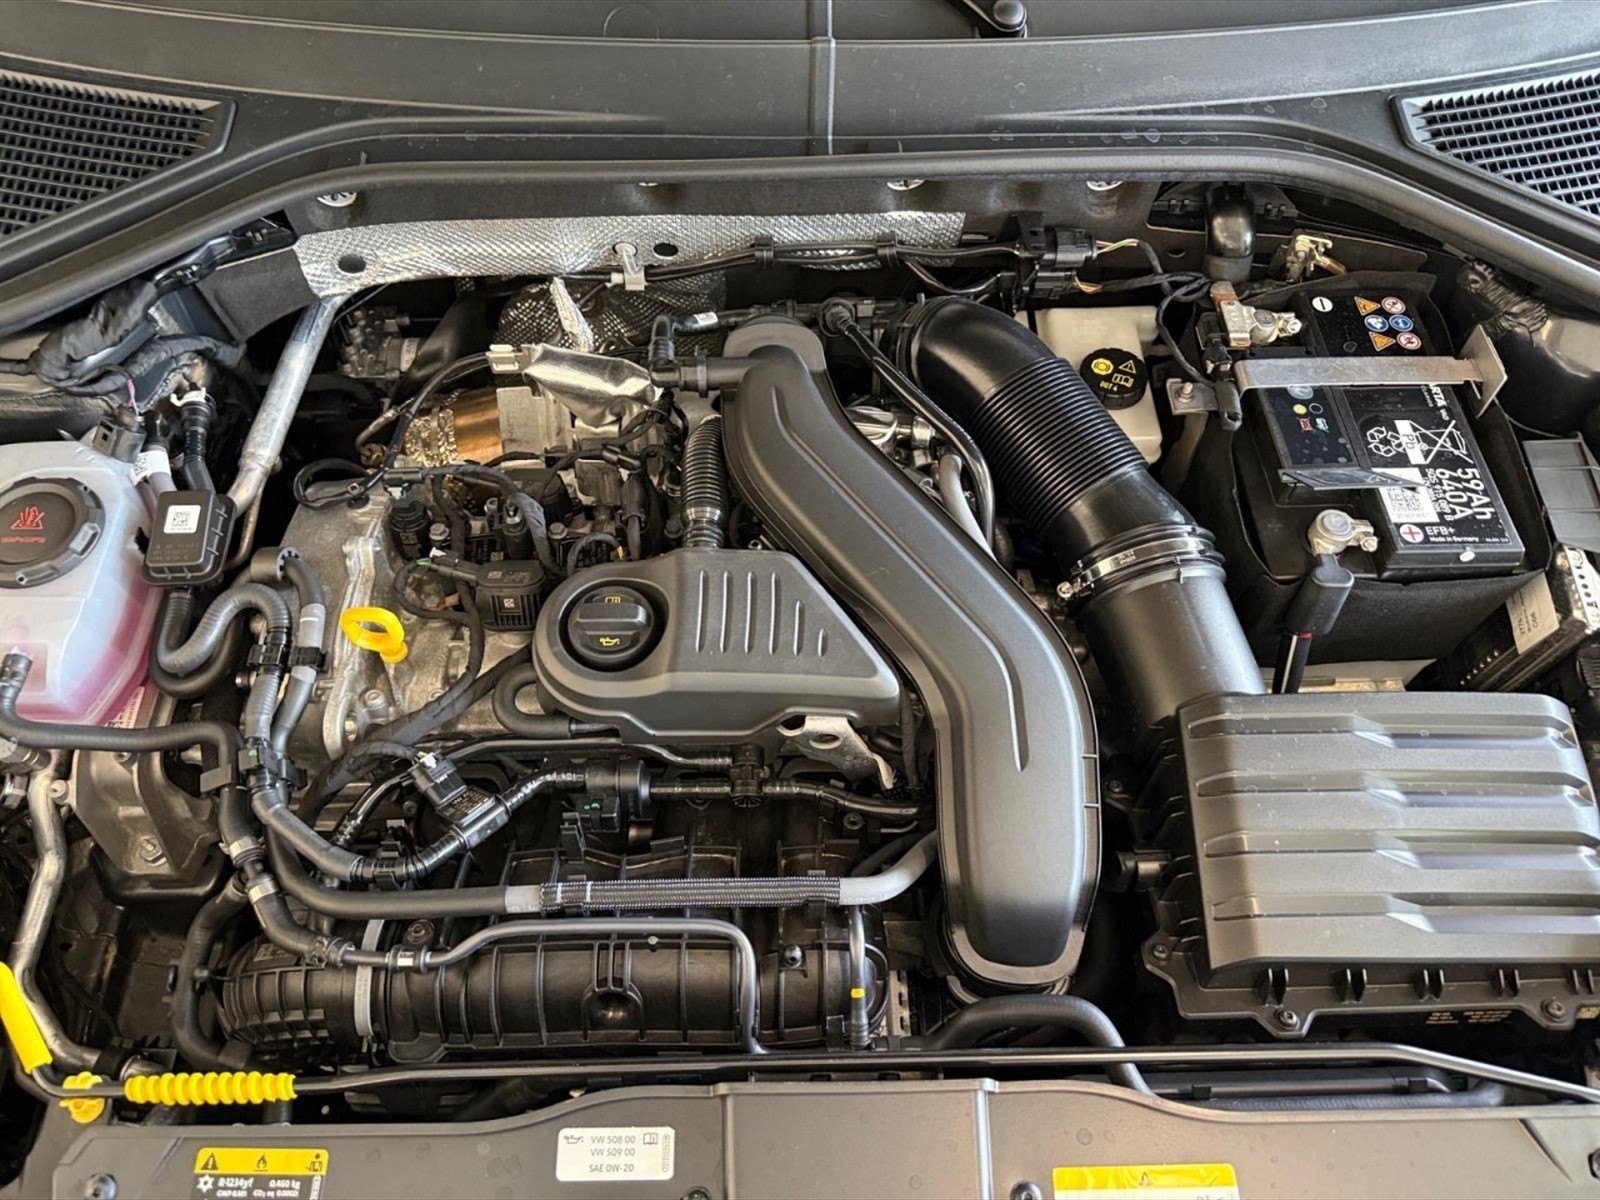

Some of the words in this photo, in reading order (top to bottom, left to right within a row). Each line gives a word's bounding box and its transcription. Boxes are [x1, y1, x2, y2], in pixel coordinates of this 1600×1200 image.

[1402, 434, 1417, 450] Pb
[1435, 468, 1474, 520] 640A
[1425, 526, 1455, 535] EFB+
[590, 1135, 605, 1144] VW
[607, 1135, 623, 1144] 508
[624, 1135, 636, 1144] 00
[590, 1148, 605, 1156] VW
[606, 1148, 623, 1157] 509
[624, 1148, 636, 1156] 00
[588, 1164, 603, 1173] SAE
[605, 1164, 634, 1173] 0W-20
